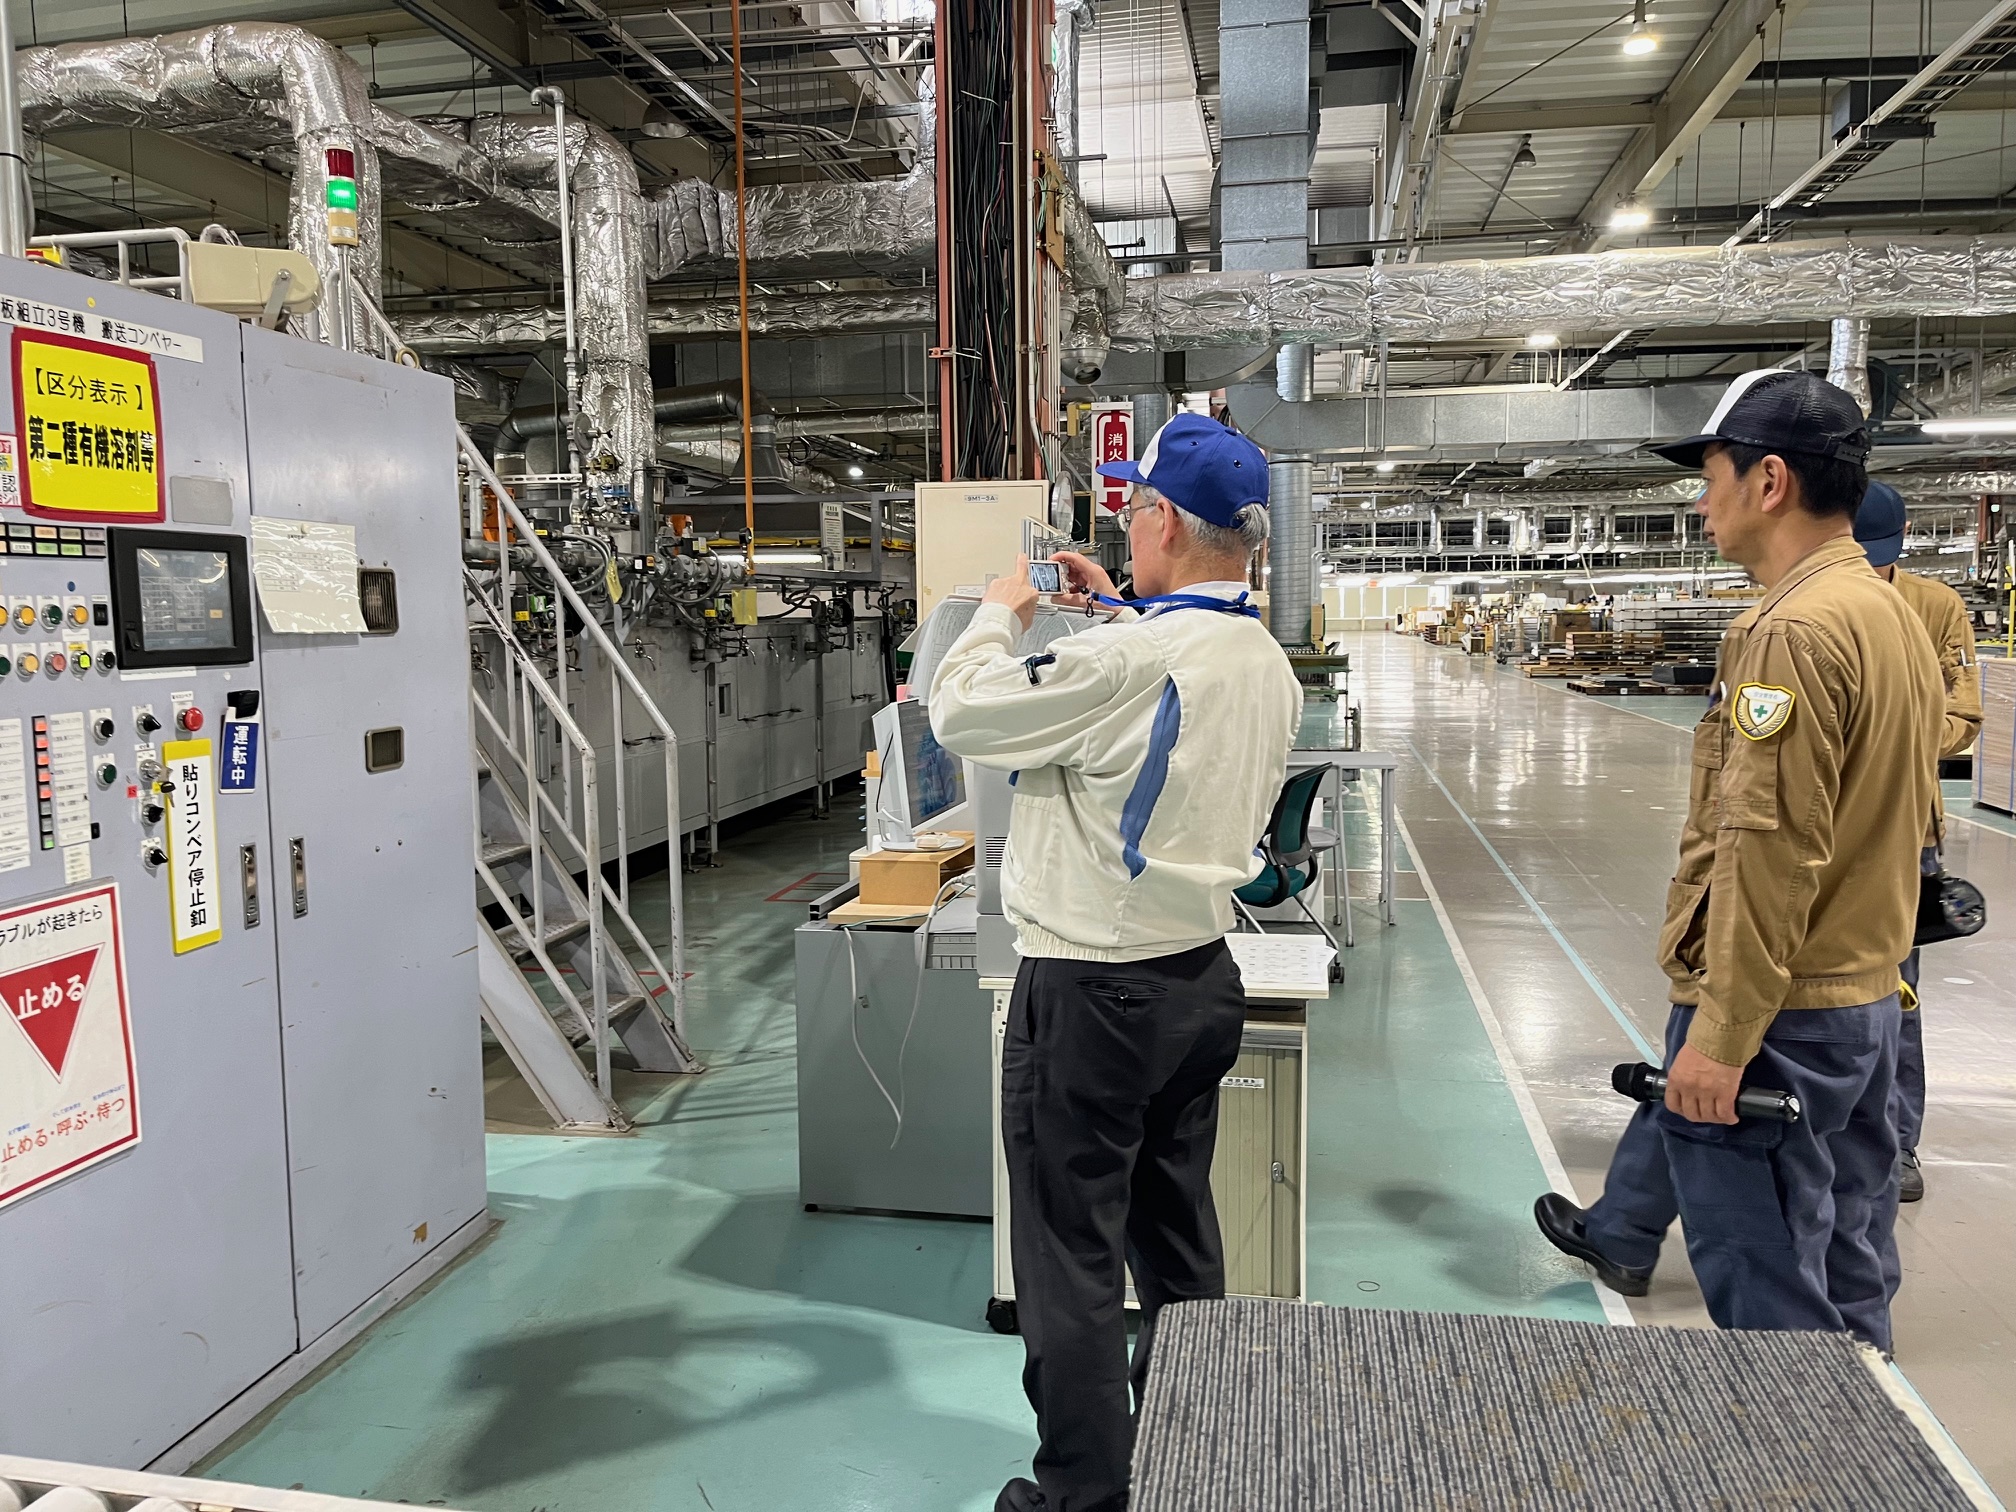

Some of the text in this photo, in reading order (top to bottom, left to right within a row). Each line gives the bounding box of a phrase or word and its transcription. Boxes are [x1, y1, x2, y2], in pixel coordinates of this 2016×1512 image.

[101, 318, 182, 352] 搬送コンベヤー
[29, 415, 155, 473] 第二種有機溶剤等
[231, 725, 249, 785] 運転中
[182, 763, 207, 928] 貼りコンベア停止釦
[17, 974, 86, 1020] 止める
